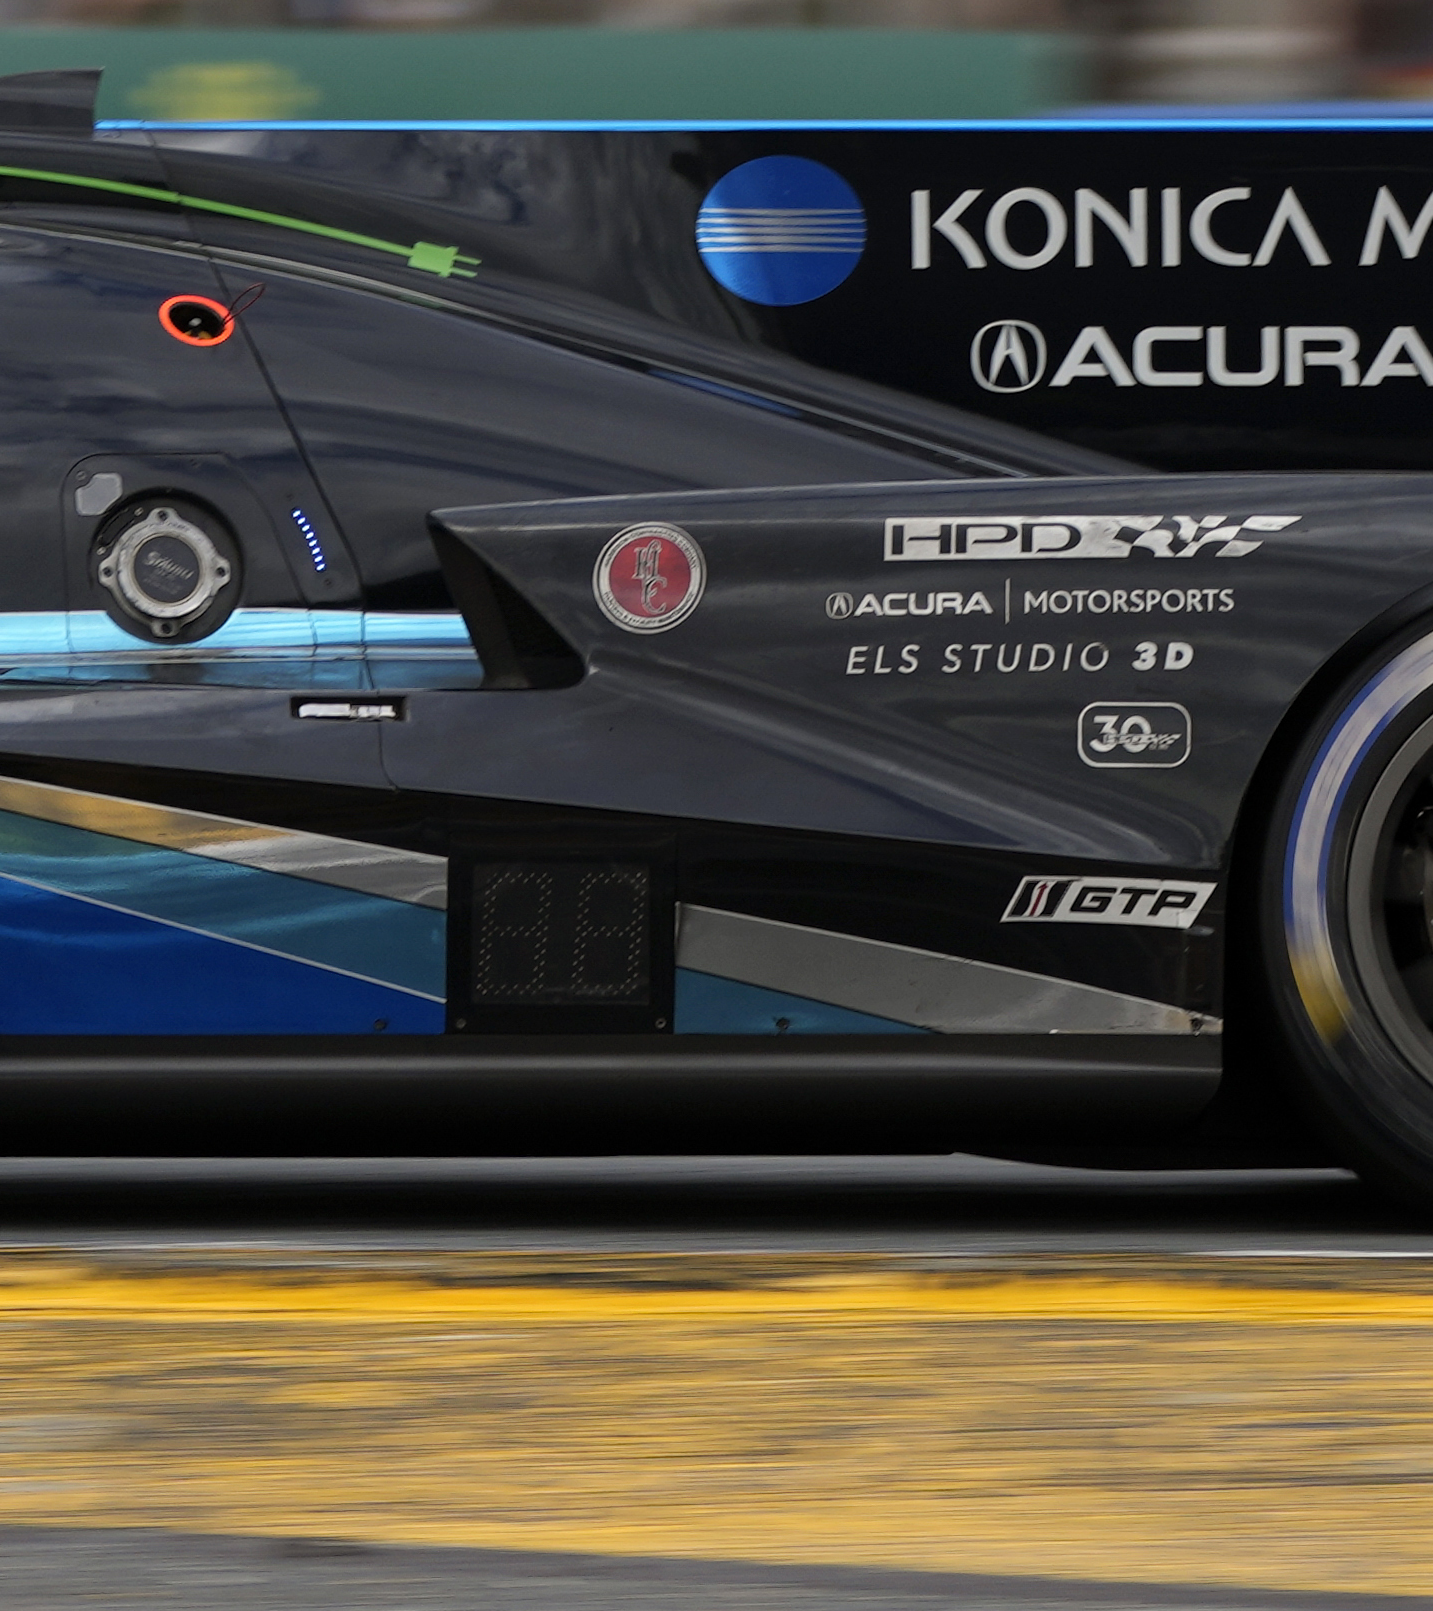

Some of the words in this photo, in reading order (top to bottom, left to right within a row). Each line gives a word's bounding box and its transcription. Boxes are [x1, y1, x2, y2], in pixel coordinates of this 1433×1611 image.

[910, 186, 1332, 270] KONICA
[891, 523, 1082, 556] HPD
[853, 591, 993, 616] ACURA
[1024, 588, 1235, 615] MOTORSPORTS
[846, 643, 921, 675] ELS
[941, 641, 1110, 674] STUDIO
[1089, 715, 1152, 753] 30
[1070, 886, 1198, 917] GTP
